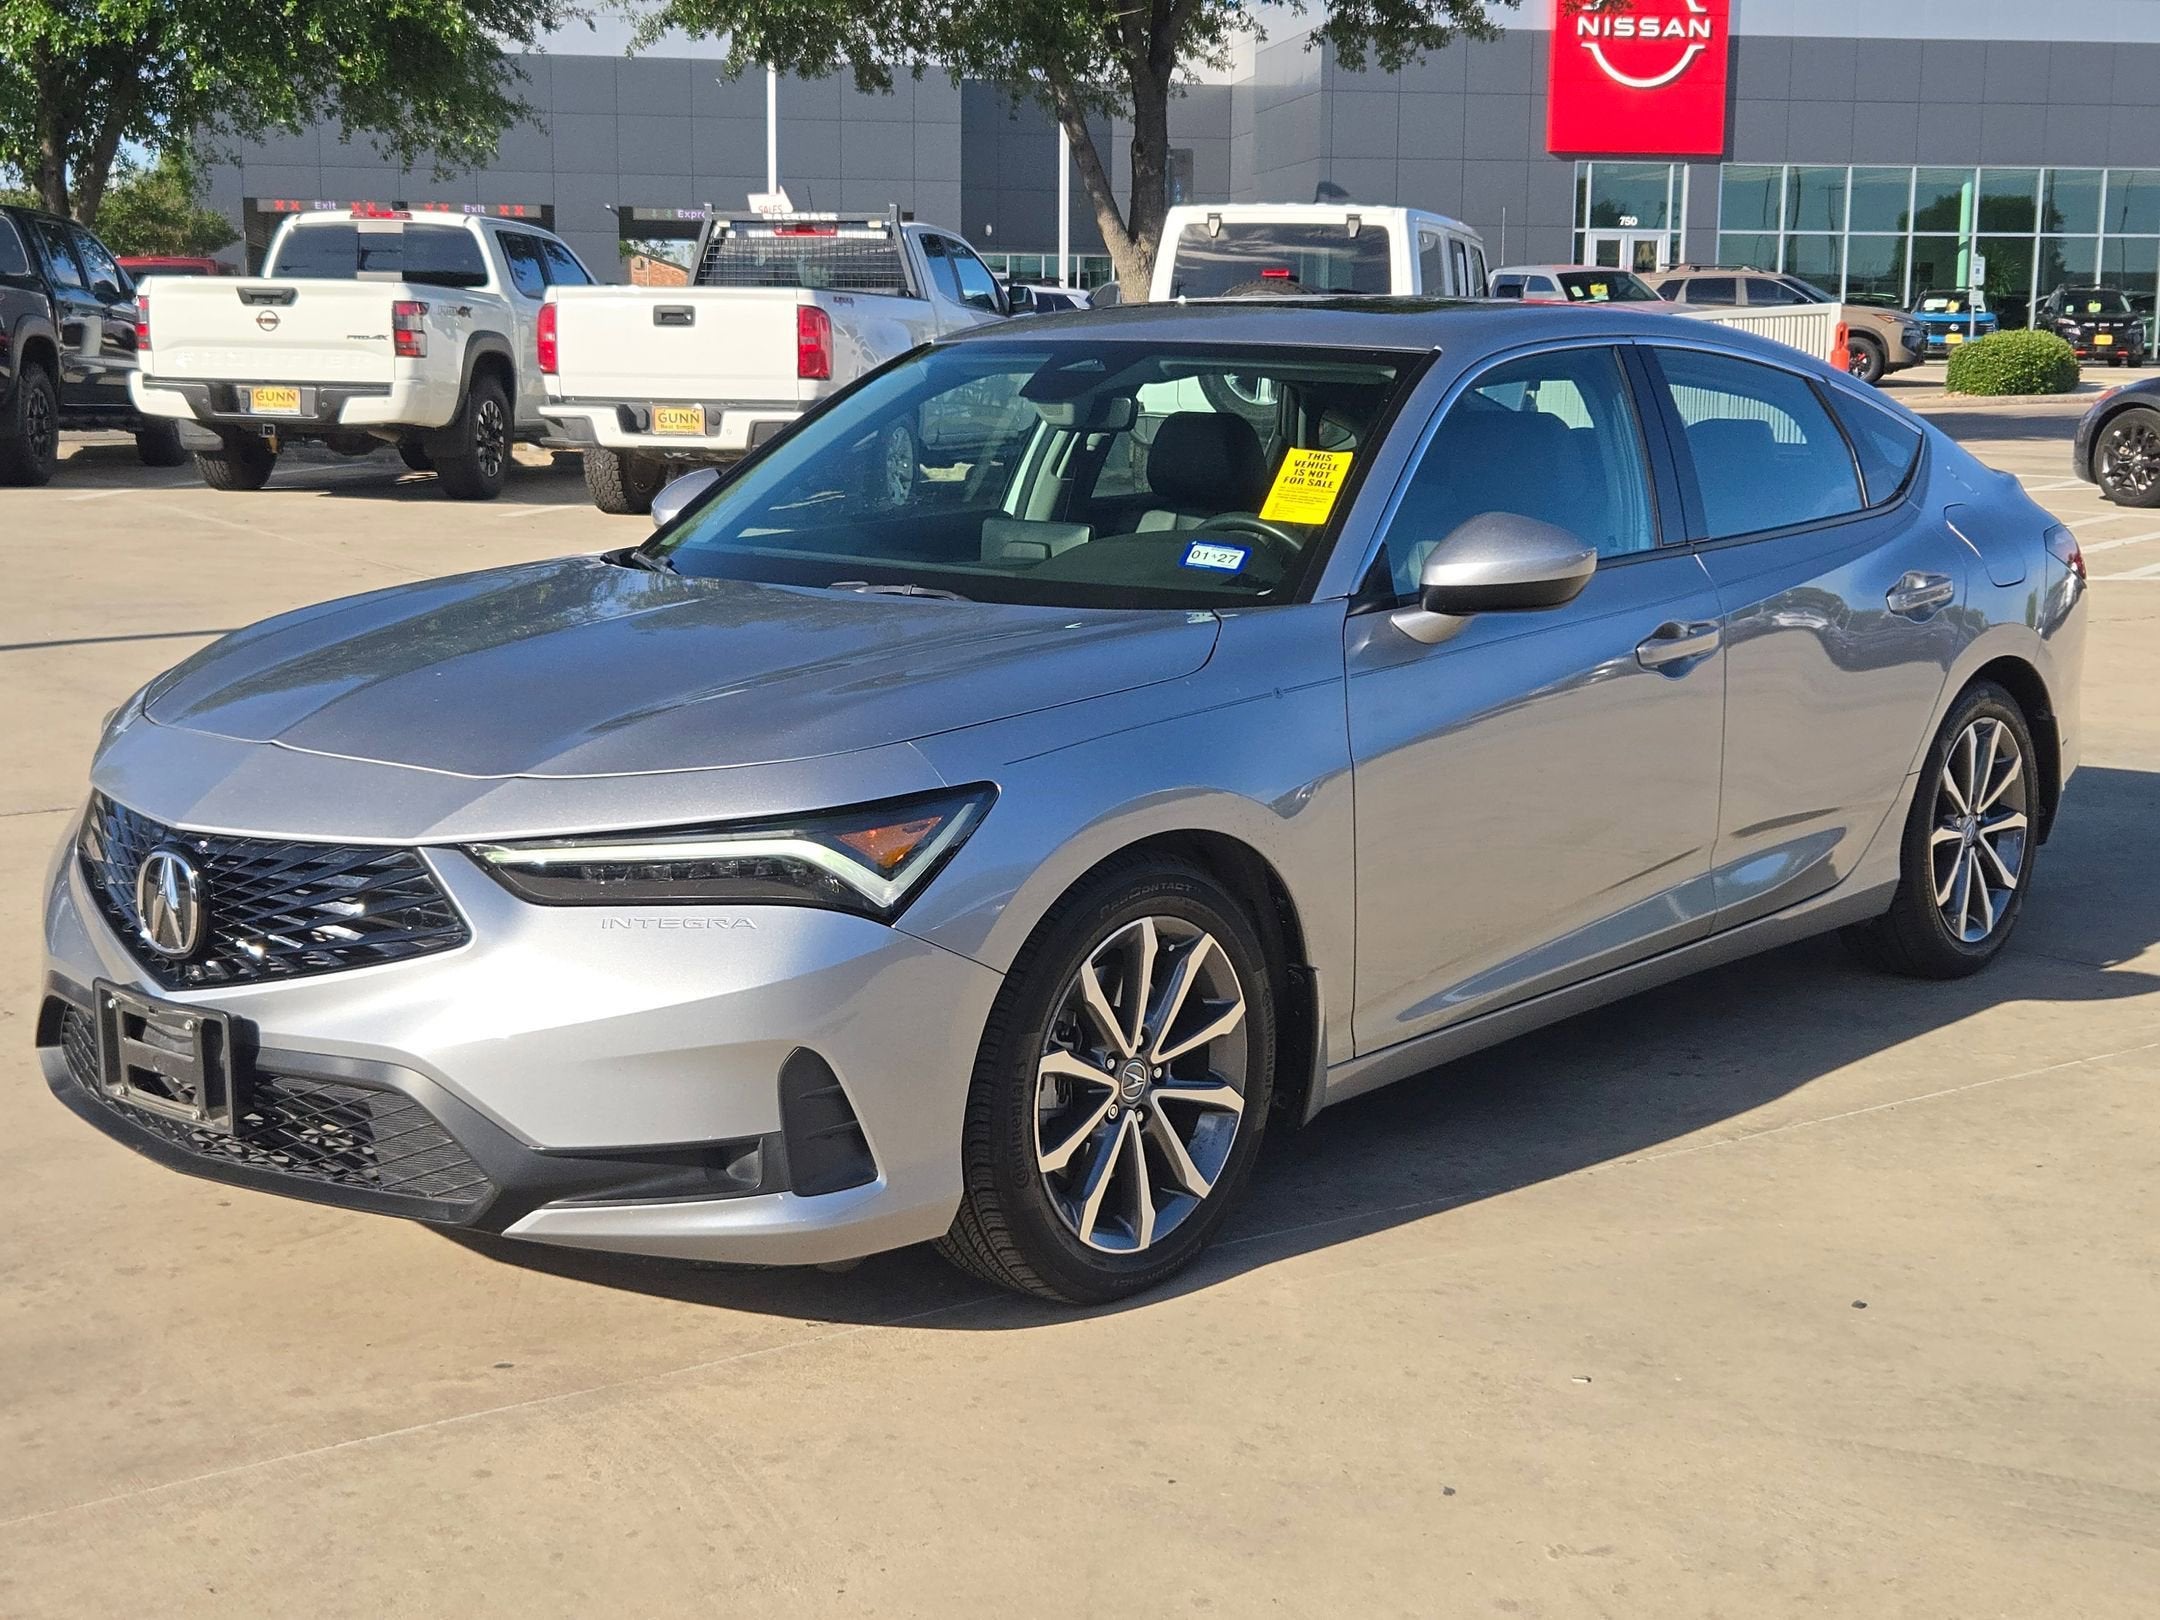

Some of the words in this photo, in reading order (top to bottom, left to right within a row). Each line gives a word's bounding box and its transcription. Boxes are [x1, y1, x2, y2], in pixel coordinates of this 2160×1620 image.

[1577, 16, 1712, 39] NISSAN
[314, 201, 337, 210] Exit
[464, 204, 486, 214] Exit
[1619, 215, 1638, 226] 750
[255, 390, 296, 402] GUNN
[657, 412, 700, 424] GUNN
[1307, 453, 1333, 462] THIS
[1294, 460, 1339, 472] VEHICLE
[1294, 468, 1305, 477] IS
[1308, 471, 1331, 479] NOT
[1283, 476, 1305, 485] FOR
[1307, 478, 1334, 489] SALE
[601, 916, 758, 930] INTEGRA
